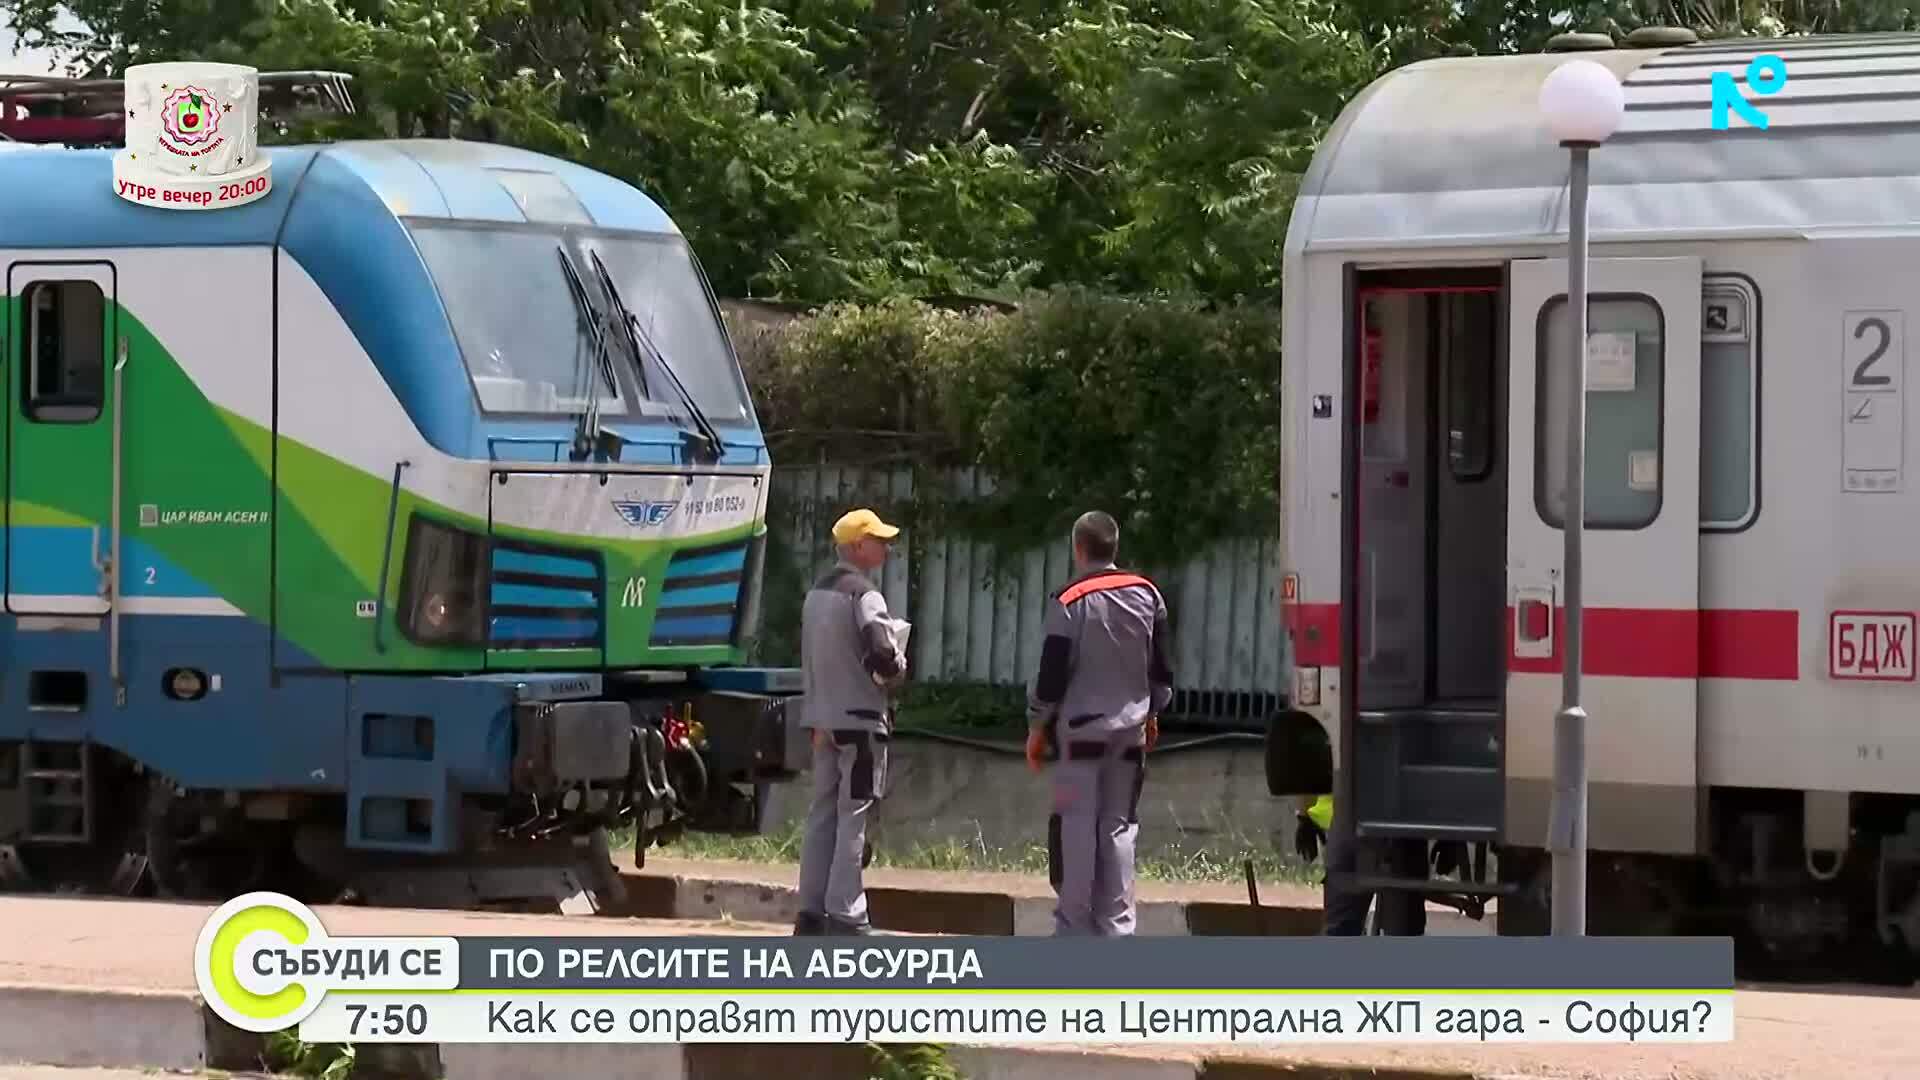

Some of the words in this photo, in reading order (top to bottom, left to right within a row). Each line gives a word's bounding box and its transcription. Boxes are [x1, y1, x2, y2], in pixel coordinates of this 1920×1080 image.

[1852, 317, 1892, 386] 2
[161, 511, 187, 524] ЦАР
[188, 510, 223, 524] ИВАН
[223, 510, 257, 524] АСЕН
[257, 510, 268, 523] II
[144, 567, 156, 585] 2
[1839, 623, 1907, 673] БДЖ
